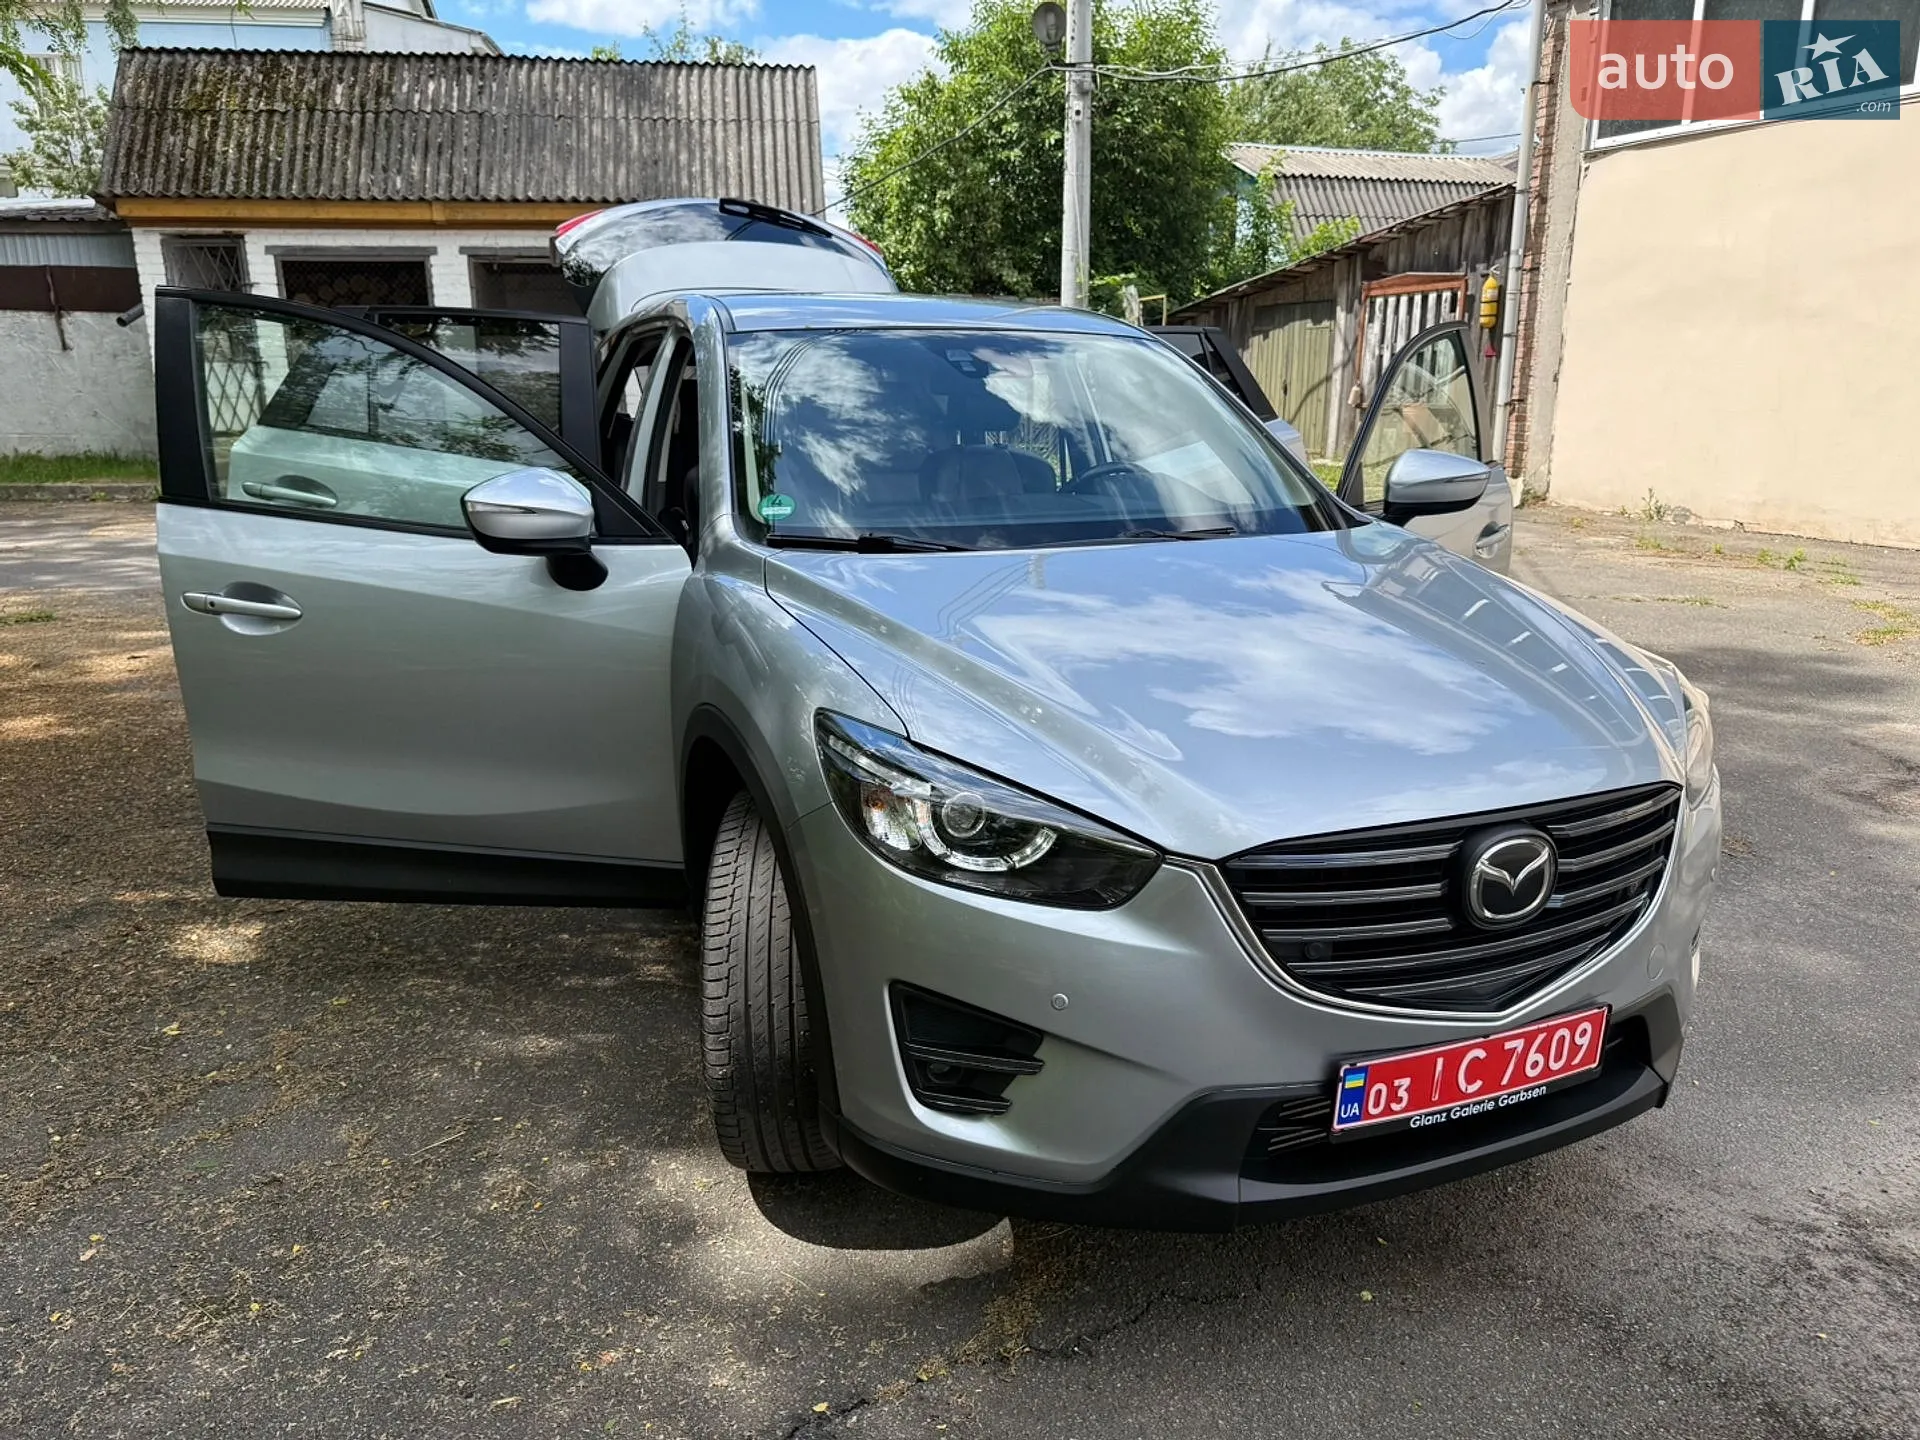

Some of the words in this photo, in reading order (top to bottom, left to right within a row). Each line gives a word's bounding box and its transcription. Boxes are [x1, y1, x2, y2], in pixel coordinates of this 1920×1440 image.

[1367, 1077, 1411, 1115] 03
[1501, 1021, 1592, 1086] 7609
[1340, 1103, 1360, 1118] UA
[1410, 1112, 1447, 1129] Glanz
[1450, 1099, 1495, 1120] Galerie
[1498, 1085, 1547, 1107] Garbsen
